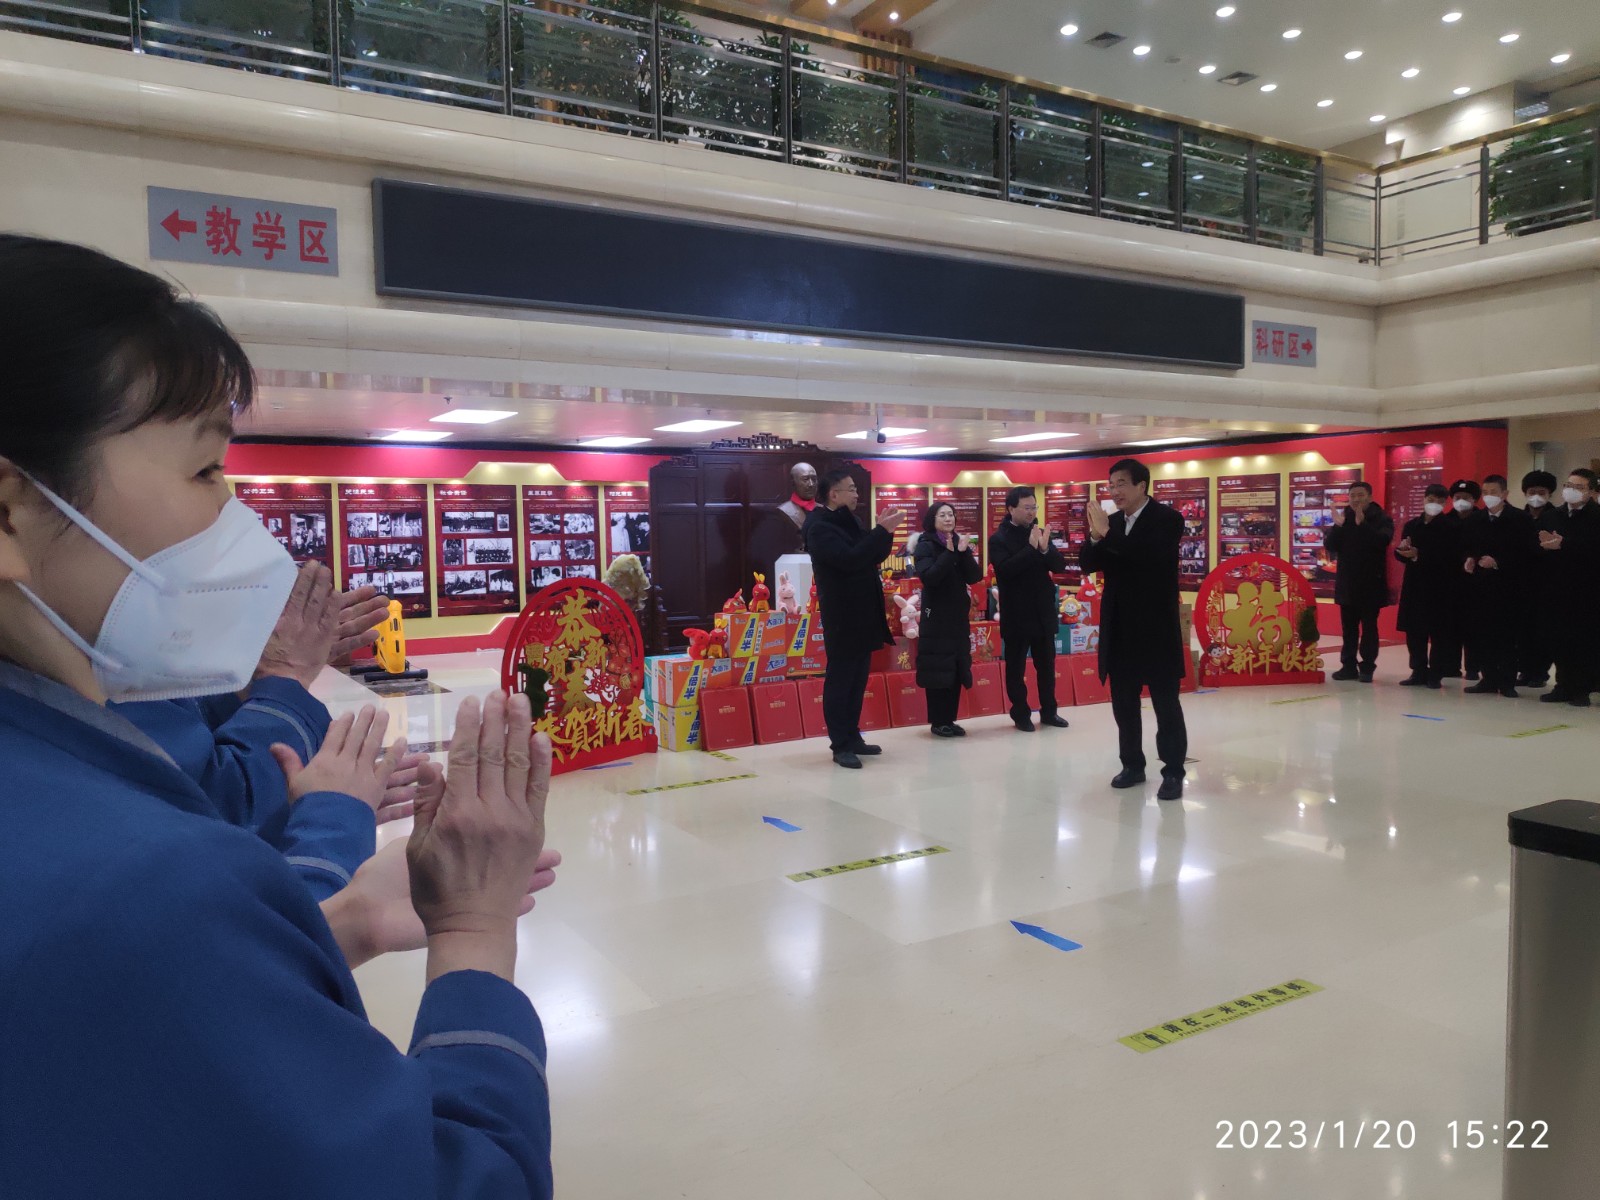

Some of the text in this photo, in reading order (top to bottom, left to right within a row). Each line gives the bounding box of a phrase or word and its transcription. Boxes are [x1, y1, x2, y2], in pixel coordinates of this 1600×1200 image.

[204, 204, 330, 264] 教学区
[1255, 327, 1300, 359] 科研区
[740, 617, 757, 652] 1倍半
[793, 617, 808, 651] 1倍半
[1222, 580, 1293, 656] 福
[1227, 641, 1325, 678] 新年快乐
[683, 664, 700, 700] 1倍半
[1161, 981, 1305, 1034] 请在一米线外等候
